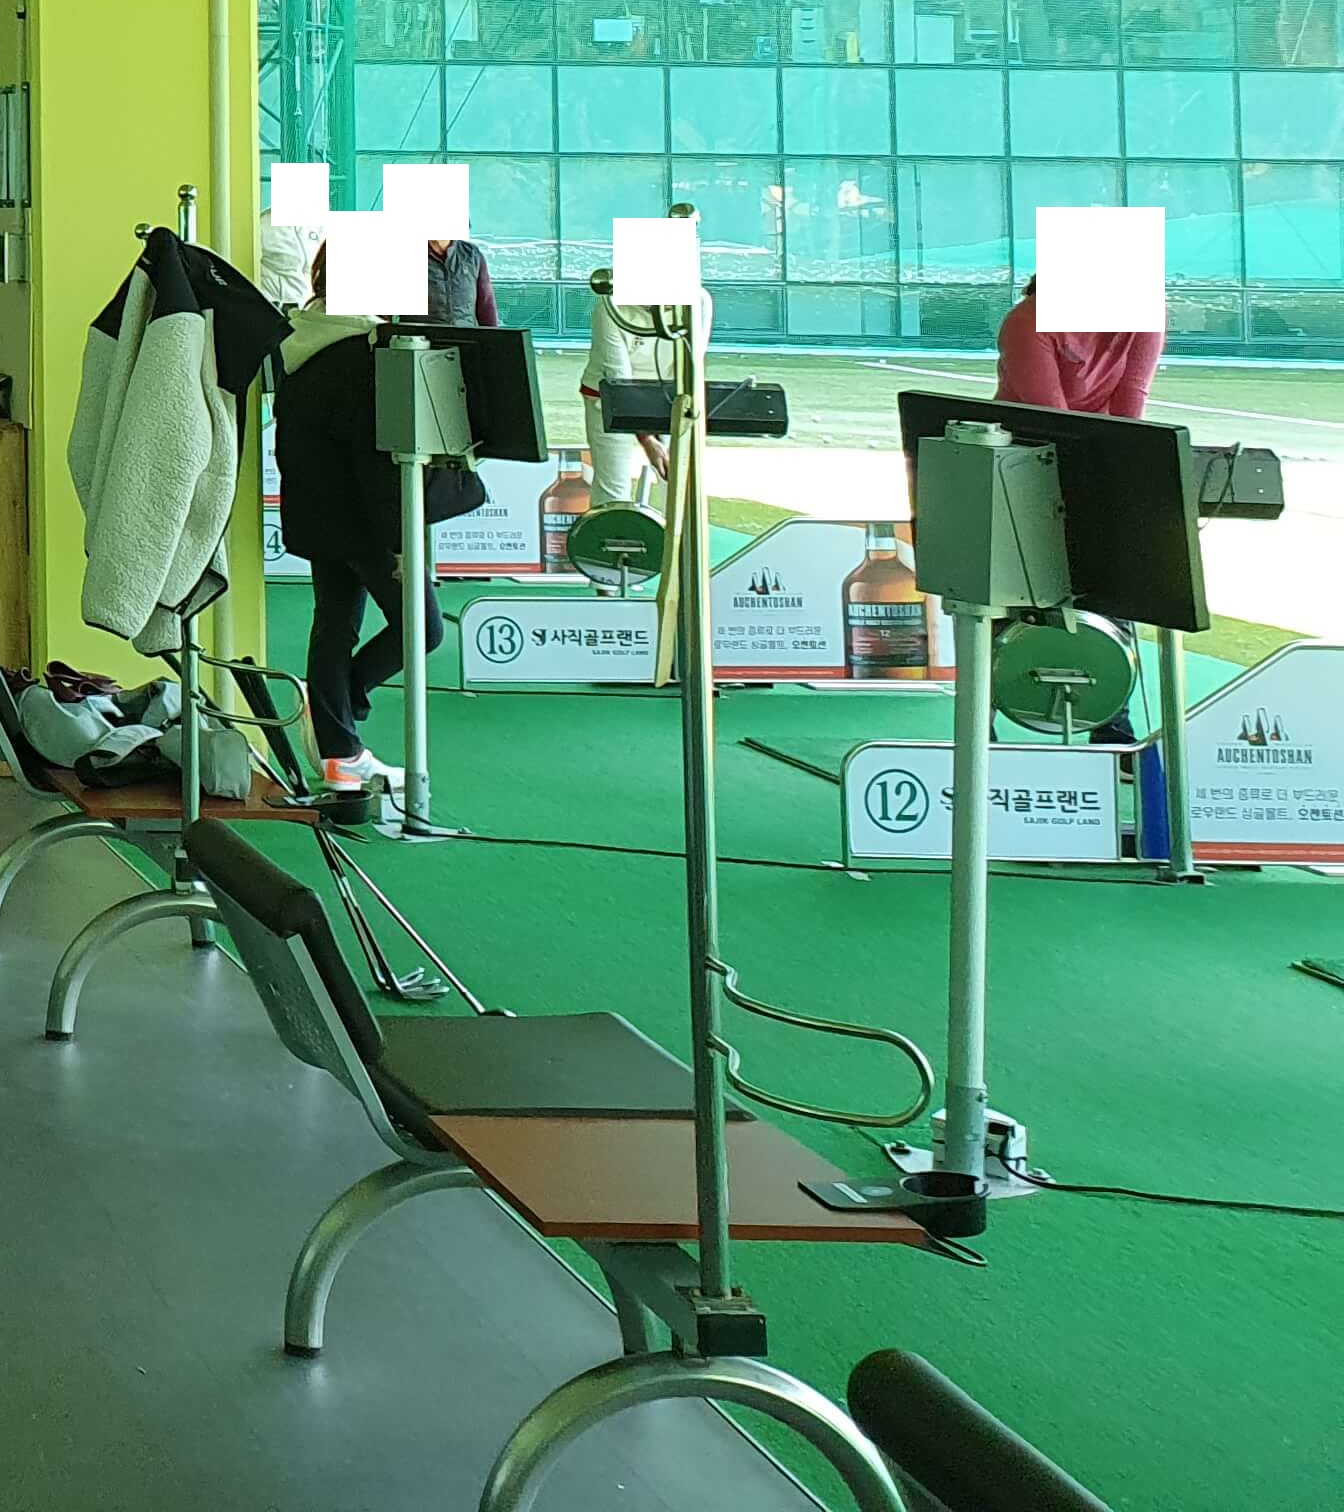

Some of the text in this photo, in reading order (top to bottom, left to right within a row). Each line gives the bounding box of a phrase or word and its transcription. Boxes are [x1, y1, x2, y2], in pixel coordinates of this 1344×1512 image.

[484, 622, 518, 657] 13
[551, 628, 650, 647] 사직골프랜드
[1216, 747, 1313, 765] AUCHENTOSHAN
[874, 778, 921, 824] 12
[989, 787, 1102, 814] 직골프랜드
